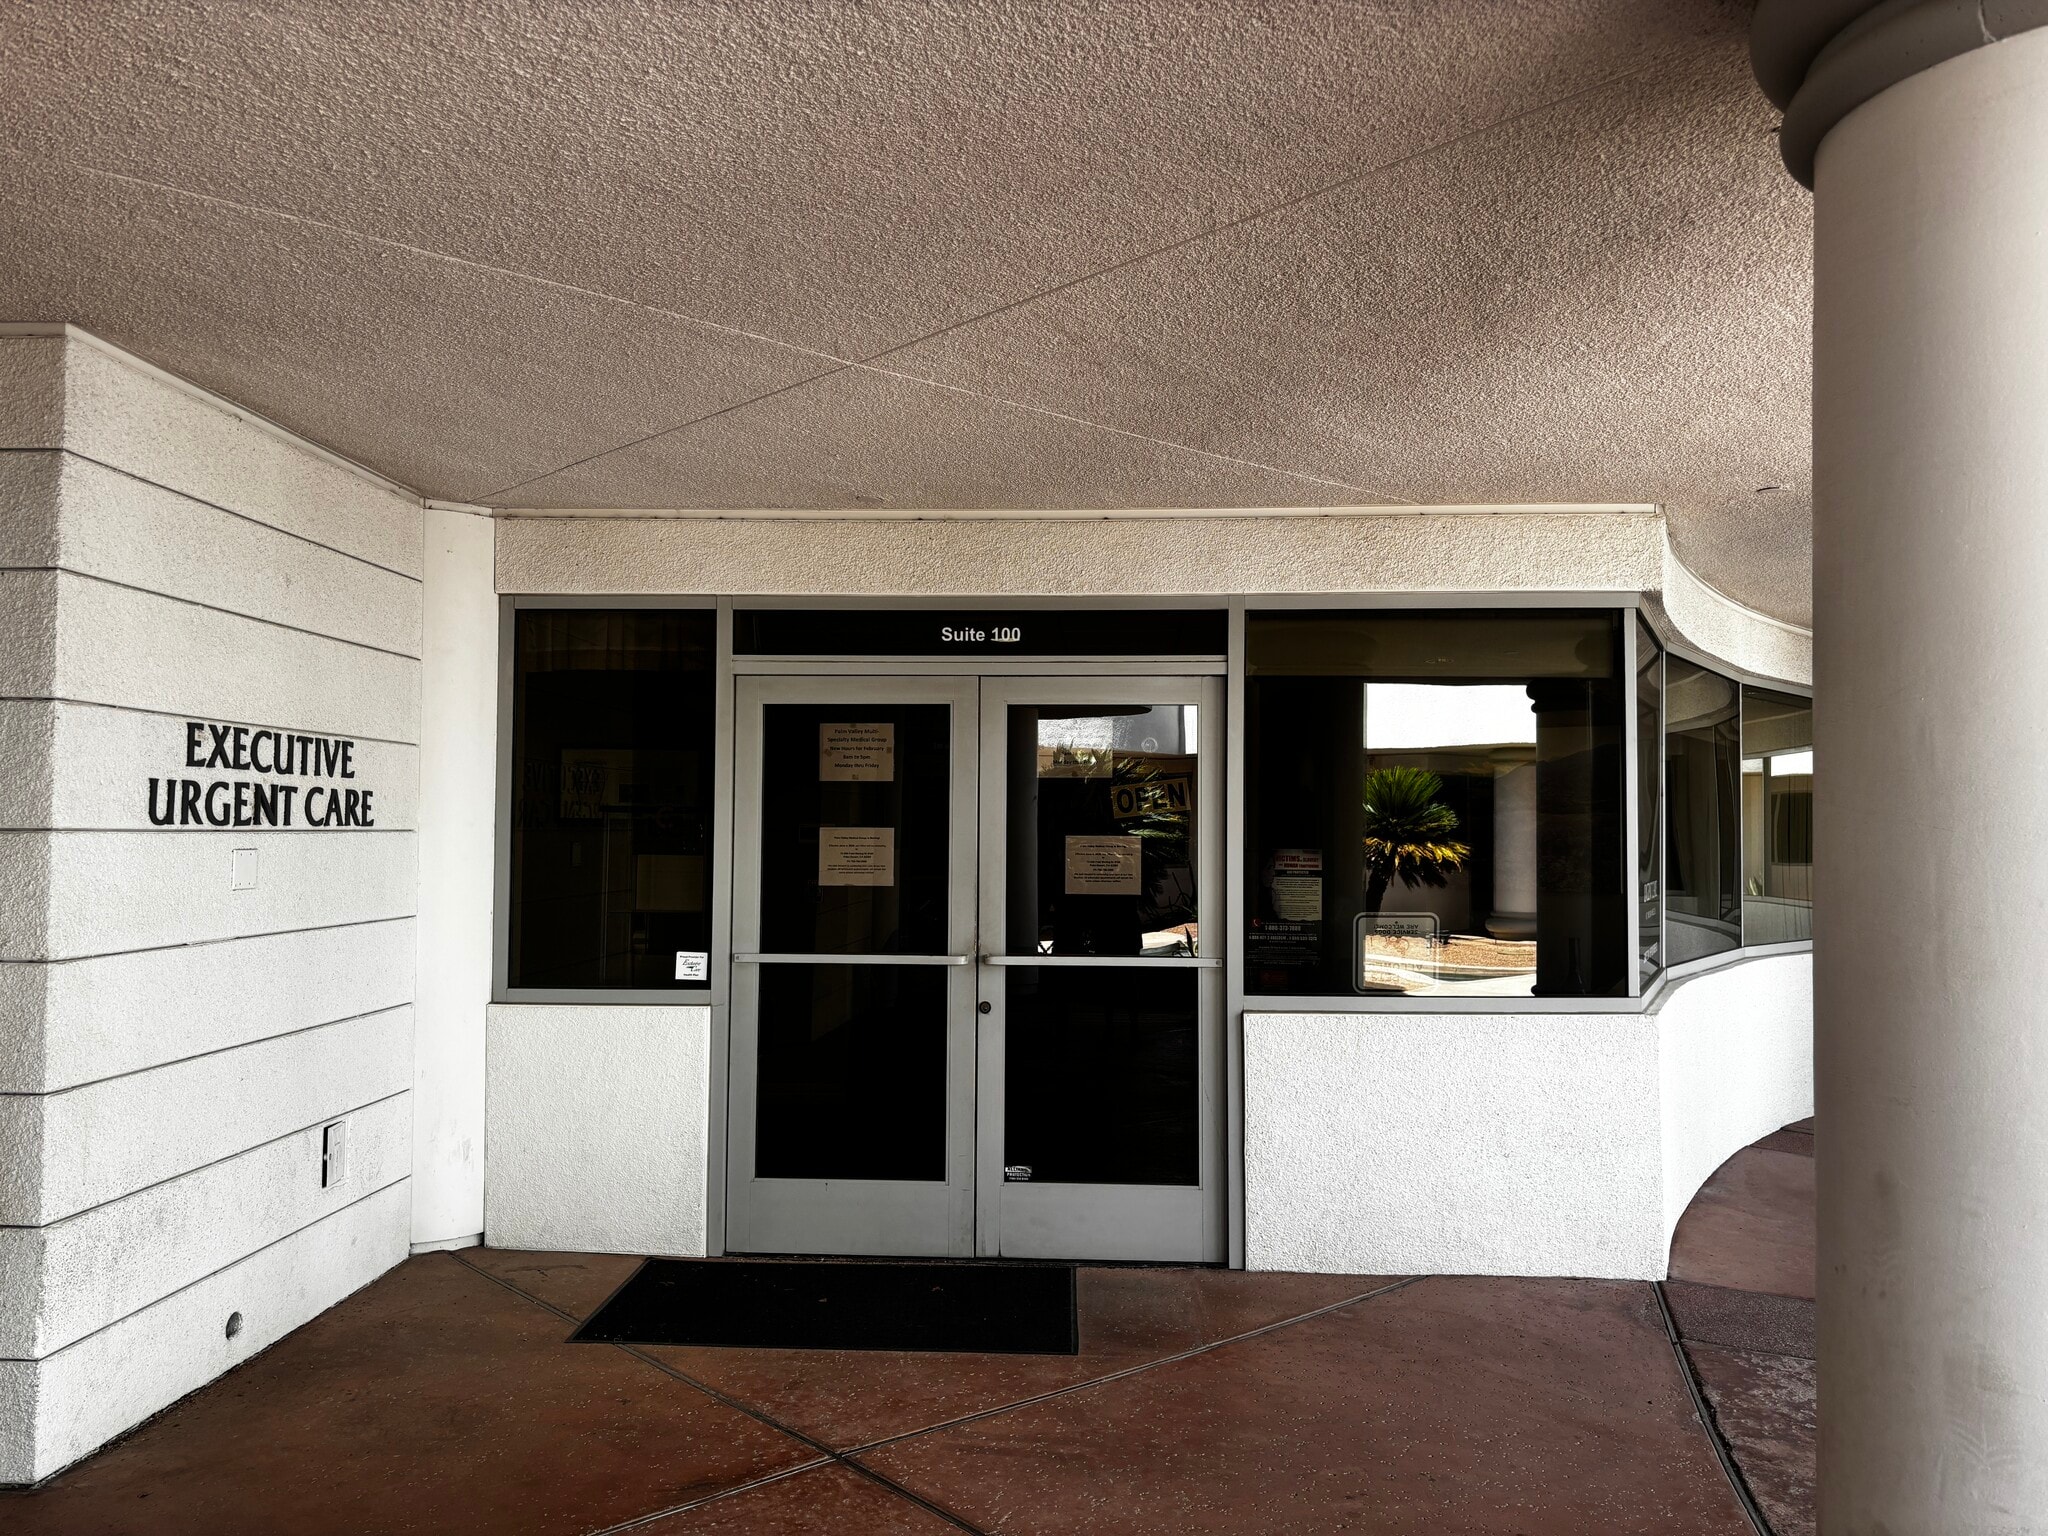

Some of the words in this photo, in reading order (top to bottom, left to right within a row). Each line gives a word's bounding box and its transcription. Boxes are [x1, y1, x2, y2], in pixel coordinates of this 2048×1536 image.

[941, 626, 985, 641] Suite
[991, 626, 1021, 642] 100
[185, 721, 356, 779] EXECUTIVE
[148, 777, 298, 827] URGENT
[304, 786, 375, 827] CARE
[1116, 781, 1186, 814] OPEN
